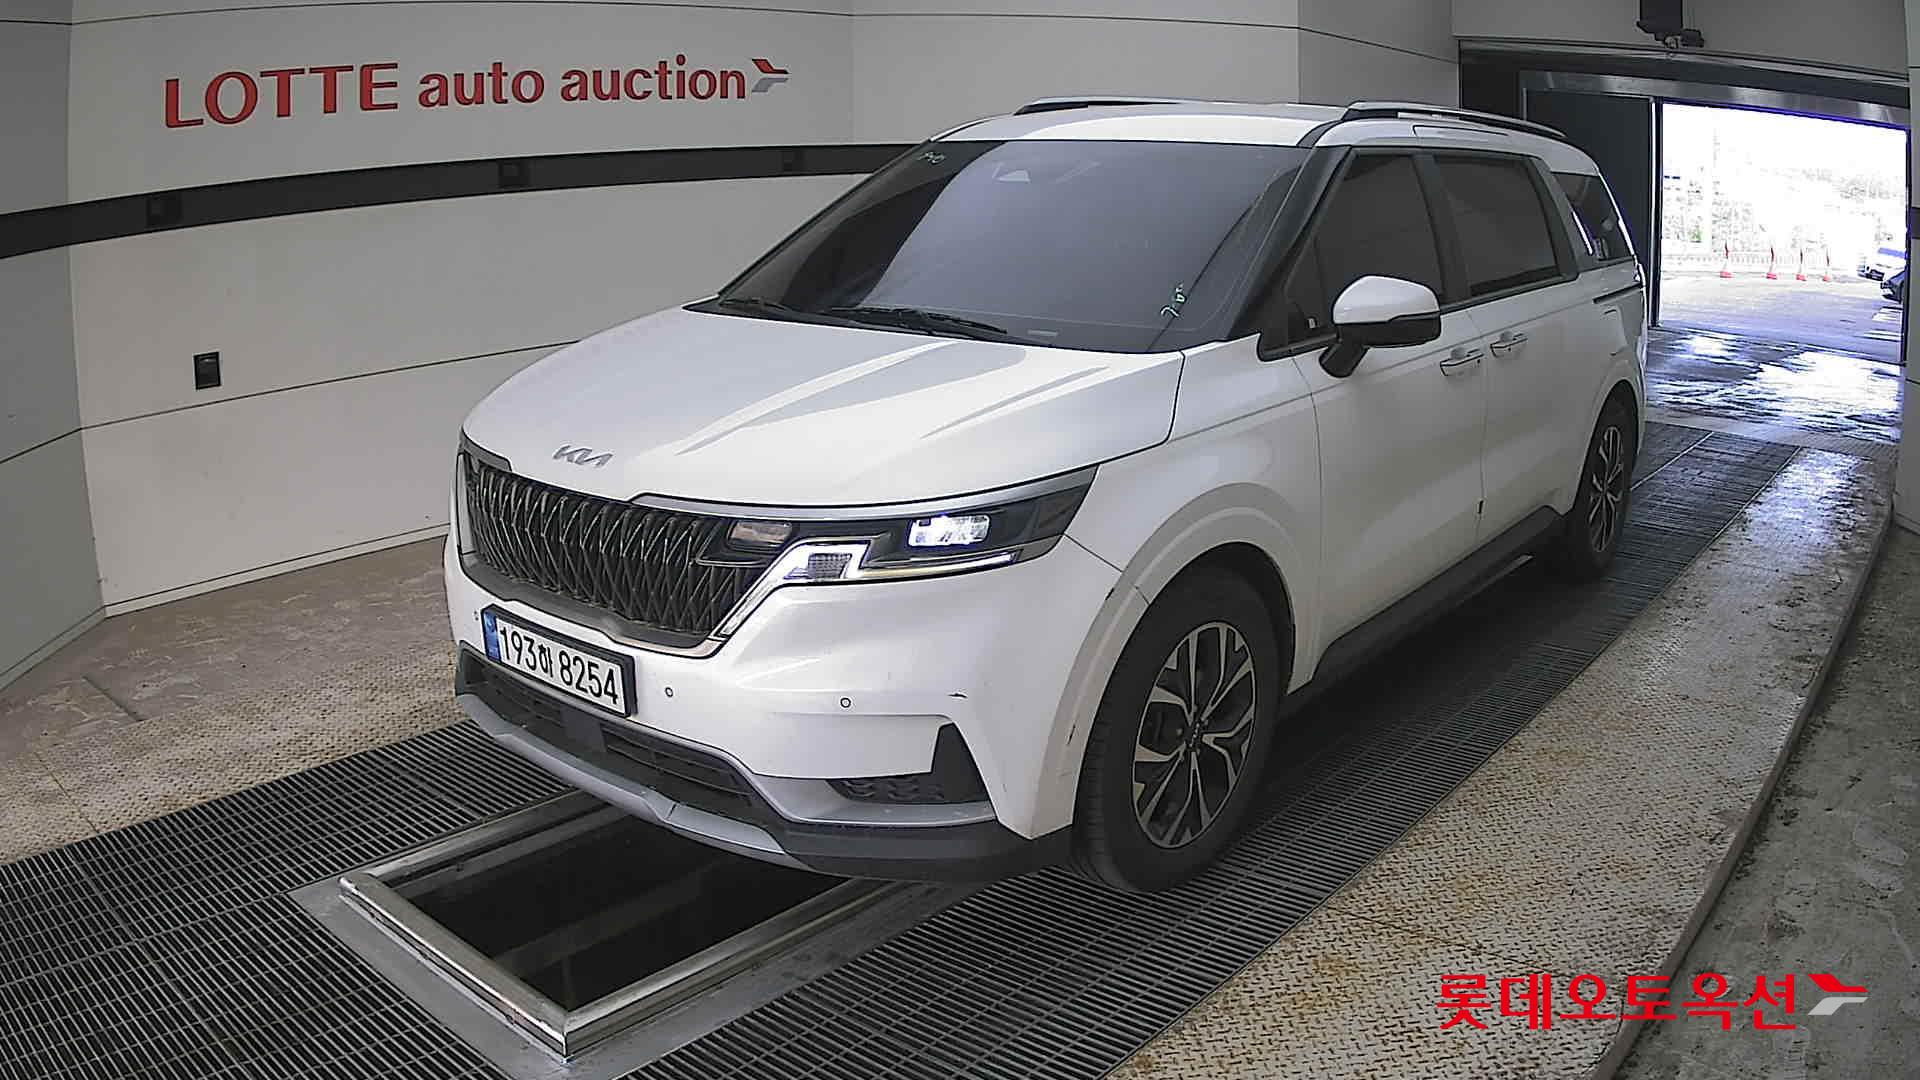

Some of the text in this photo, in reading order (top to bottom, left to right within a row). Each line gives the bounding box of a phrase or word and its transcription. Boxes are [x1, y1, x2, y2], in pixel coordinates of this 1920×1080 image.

[165, 54, 746, 128] LOTTE auto auction
[552, 444, 613, 467] KIA
[559, 650, 618, 704] 8254
